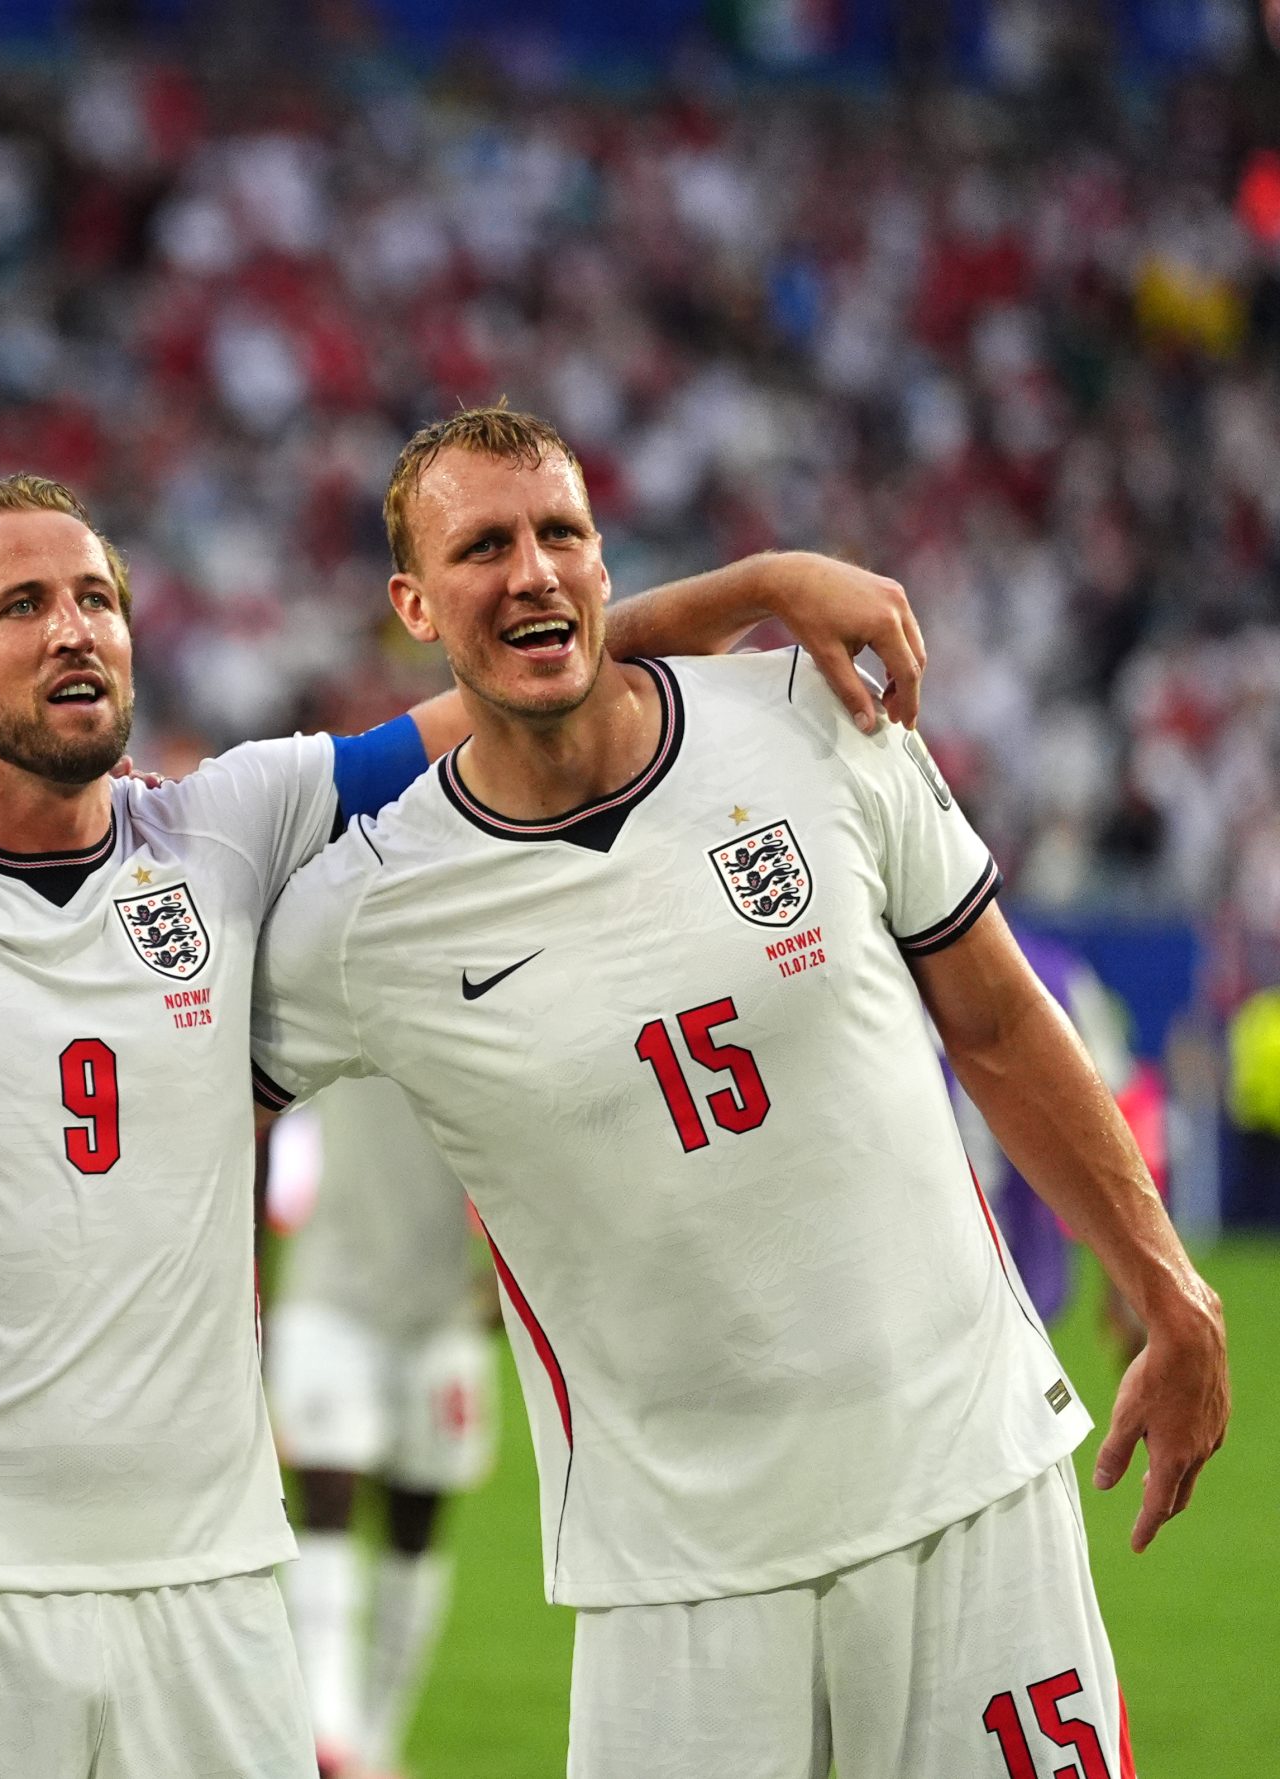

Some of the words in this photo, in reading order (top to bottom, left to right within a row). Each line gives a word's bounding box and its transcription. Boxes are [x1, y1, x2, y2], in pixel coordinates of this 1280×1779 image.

[765, 926, 822, 961] NORWAY
[779, 948, 826, 978] 11.07.26
[164, 987, 210, 1009] NORWAY
[174, 1009, 212, 1029] 11.07.26
[634, 996, 771, 1153] 15
[59, 1038, 120, 1174] 9
[982, 1668, 1111, 1779] 15
